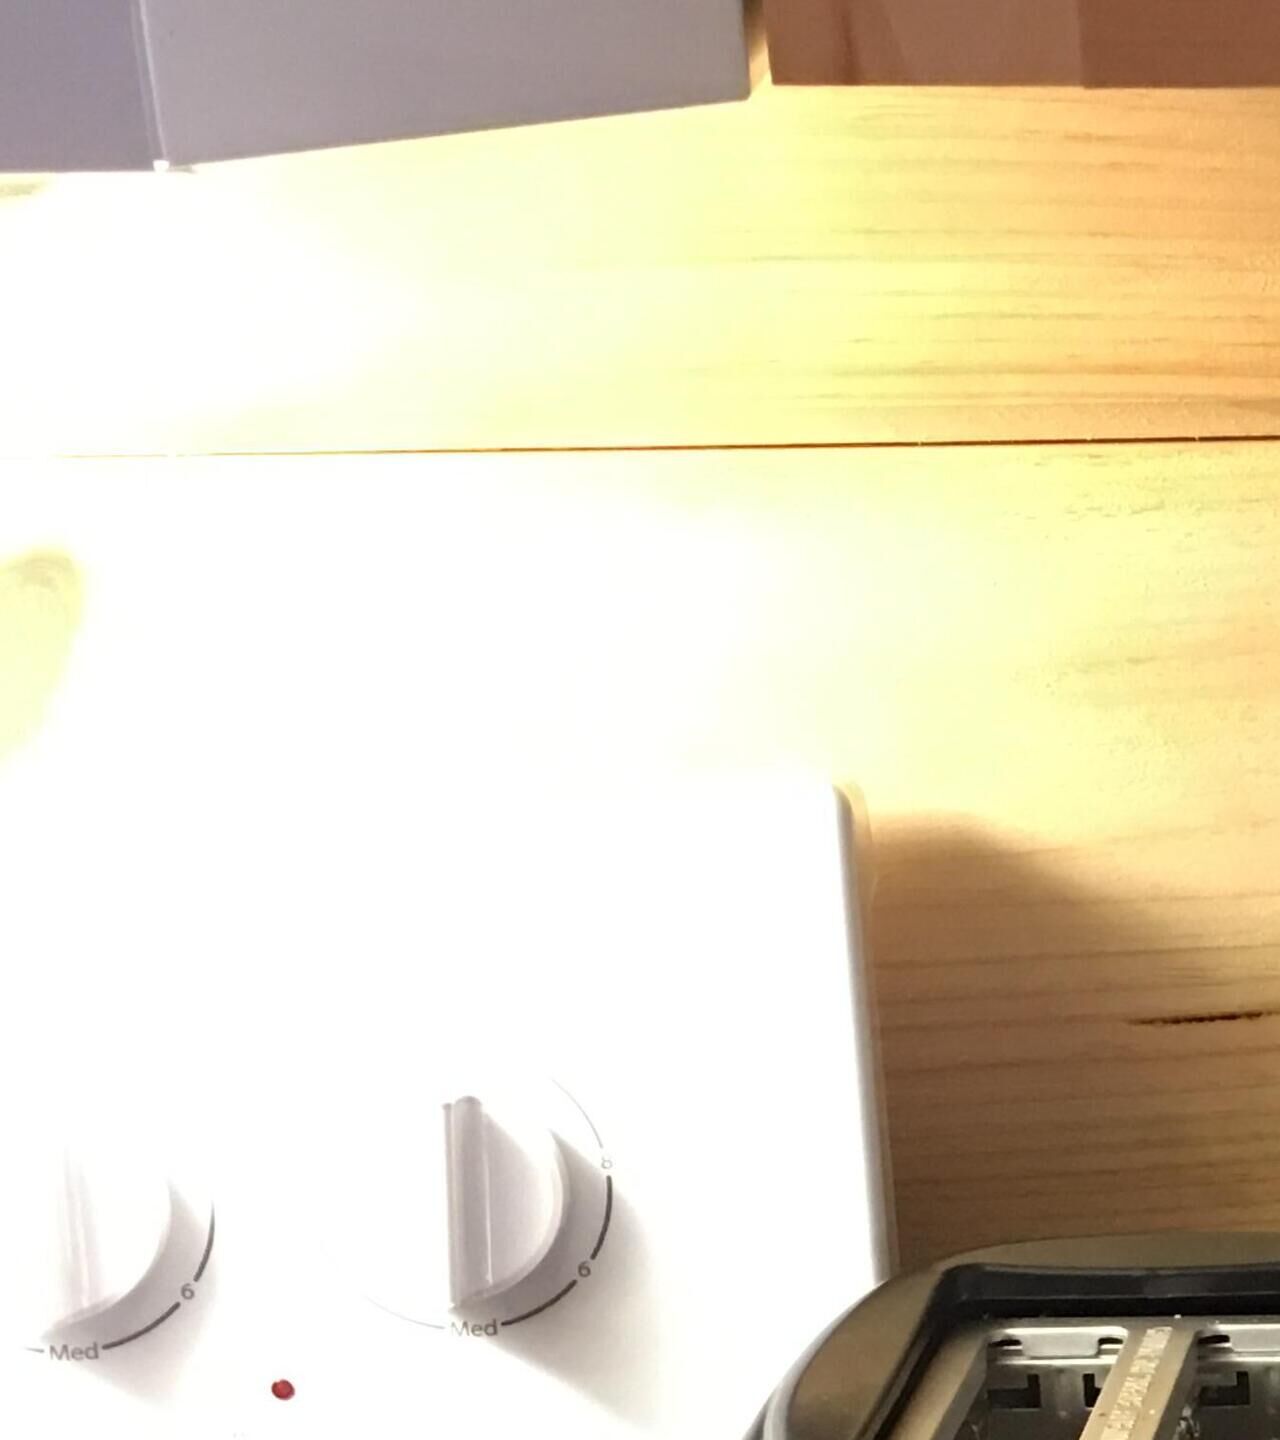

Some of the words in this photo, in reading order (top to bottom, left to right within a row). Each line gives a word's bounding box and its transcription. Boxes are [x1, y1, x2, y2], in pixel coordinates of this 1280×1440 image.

[577, 1261, 591, 1278] 6
[181, 1282, 195, 1301] 6
[451, 1319, 498, 1337] Med
[50, 1342, 99, 1361] Med
